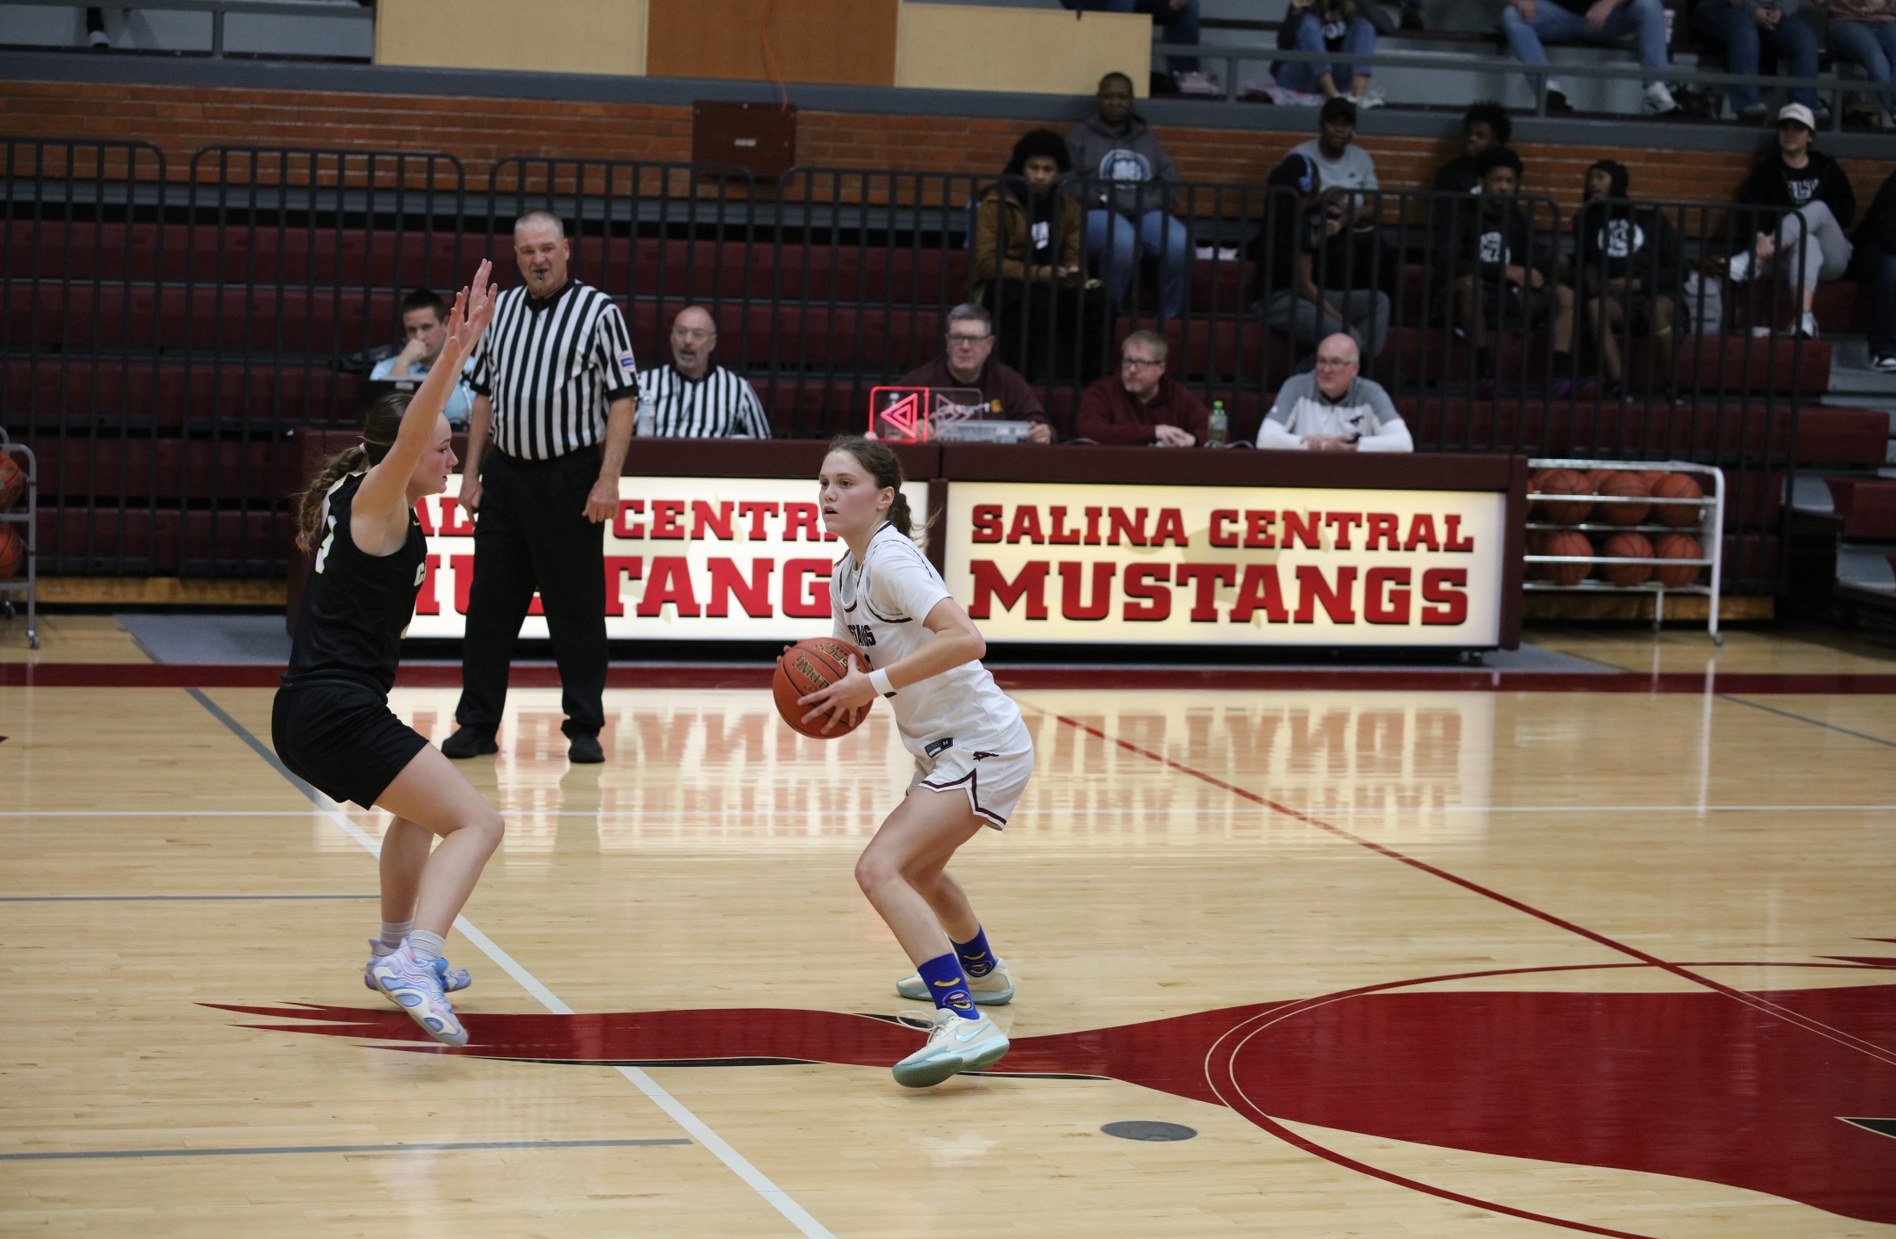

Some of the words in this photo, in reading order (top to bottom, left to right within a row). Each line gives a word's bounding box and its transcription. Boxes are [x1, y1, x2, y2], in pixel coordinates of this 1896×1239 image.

[613, 499, 838, 542] CENTR
[972, 504, 1188, 547] SALINA
[1209, 509, 1474, 552] CENTRAL
[968, 560, 1468, 625] MUSTANGS
